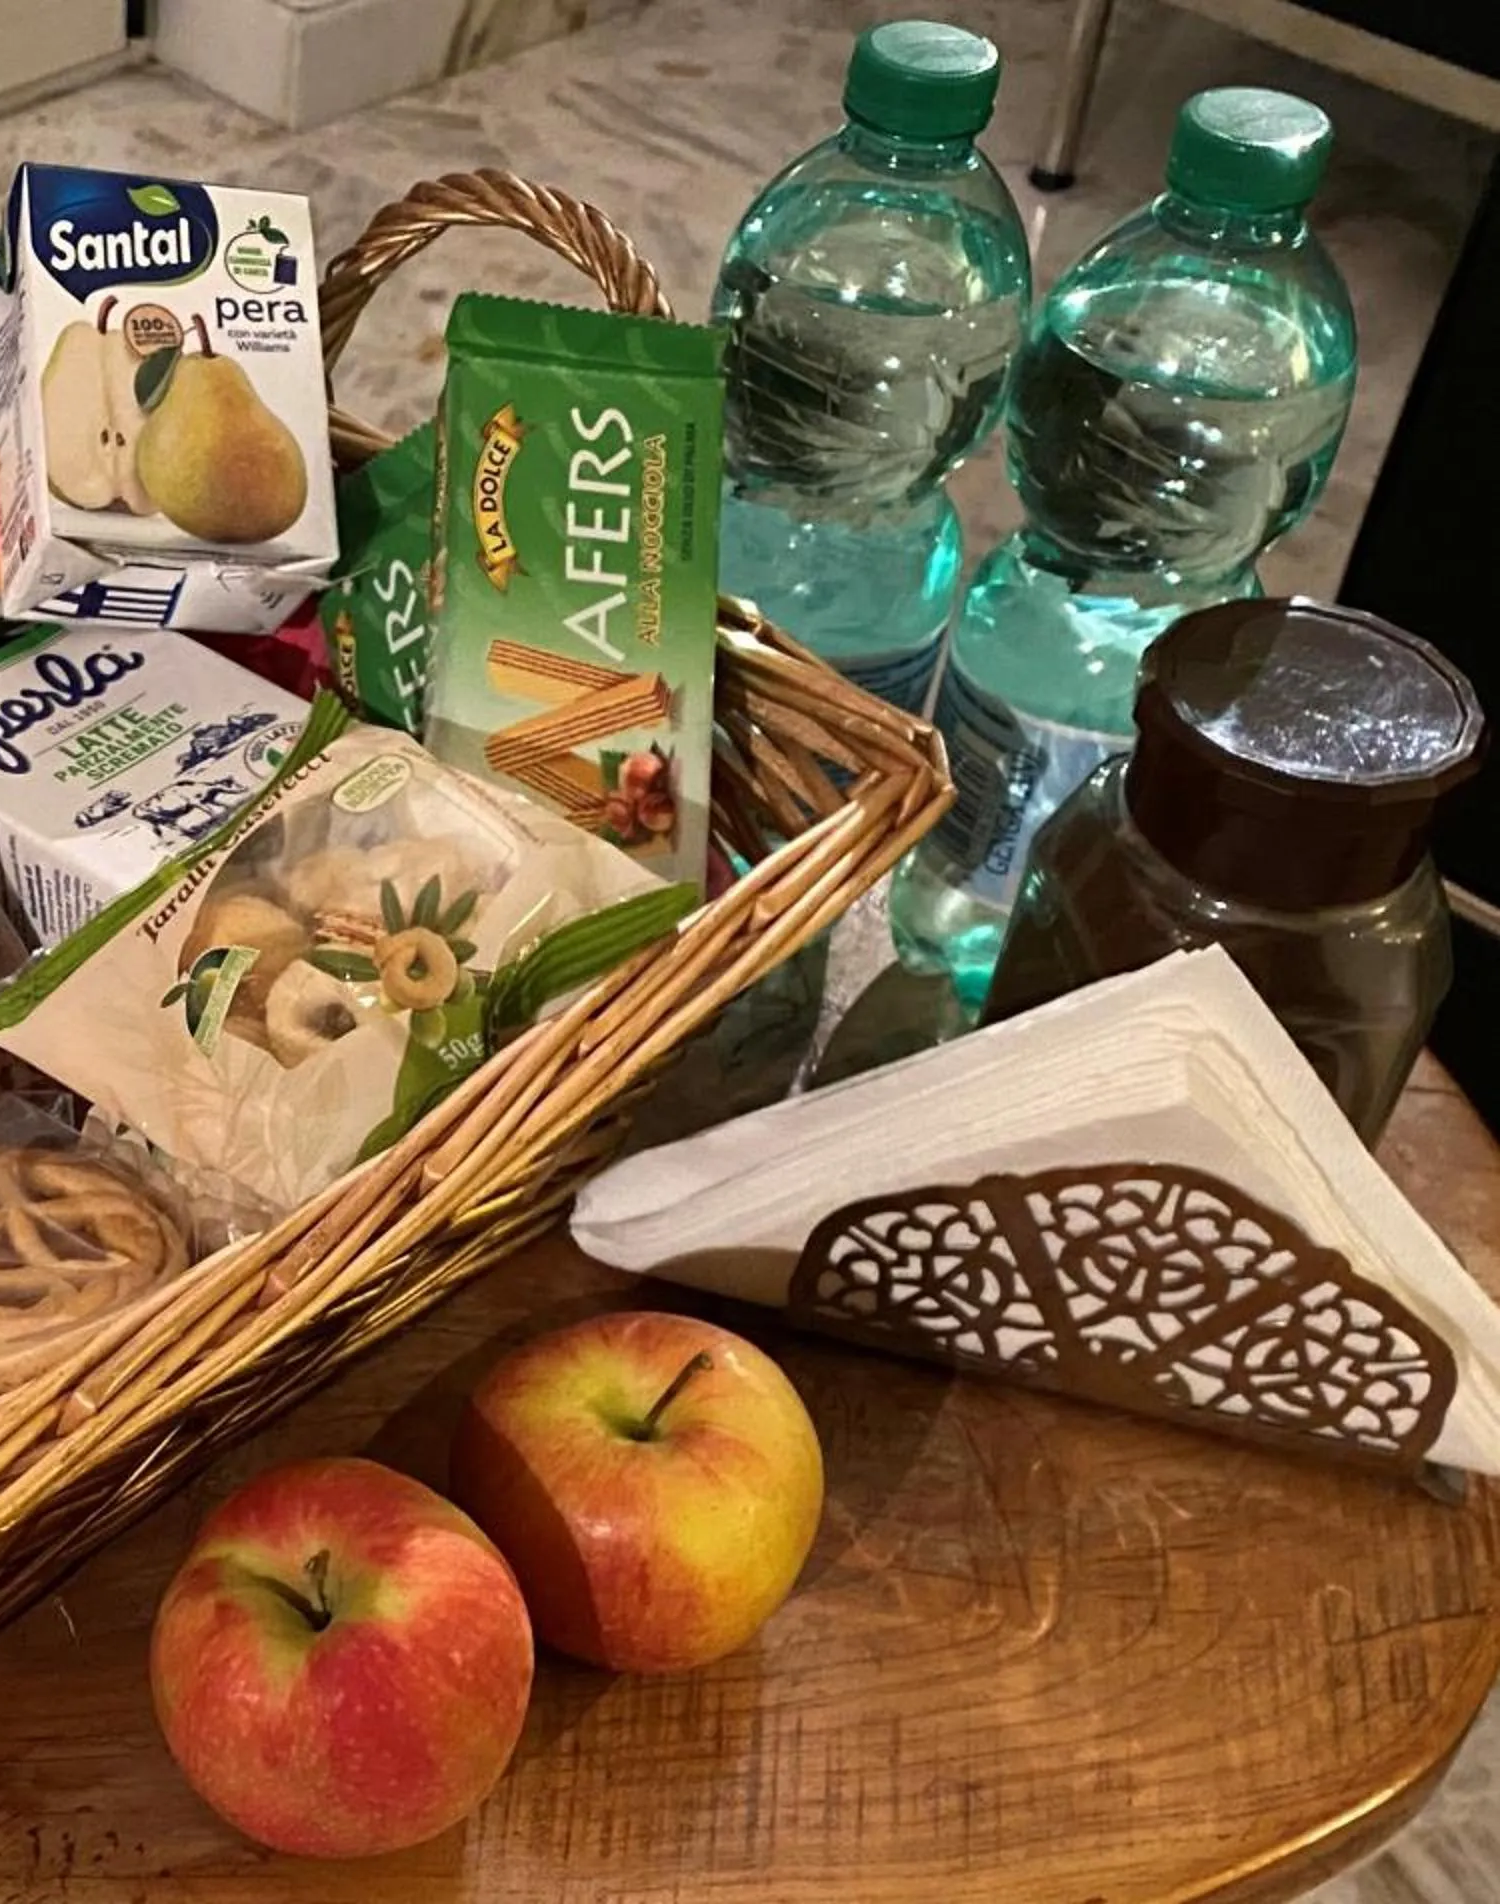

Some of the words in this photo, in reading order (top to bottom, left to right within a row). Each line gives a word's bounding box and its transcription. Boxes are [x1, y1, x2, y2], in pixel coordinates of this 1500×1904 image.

[49, 217, 191, 271] Santal
[215, 296, 308, 329] pera
[479, 438, 512, 513] DOLCE
[641, 432, 668, 573] NOCCIOLA
[486, 521, 508, 553] LA
[638, 577, 662, 650] ALLA
[53, 702, 188, 783] PARZIALMENTE
[58, 706, 148, 759] LATTE
[85, 721, 184, 781] SCREMATO
[136, 858, 217, 945] Taralli
[437, 1031, 485, 1071] 50g
